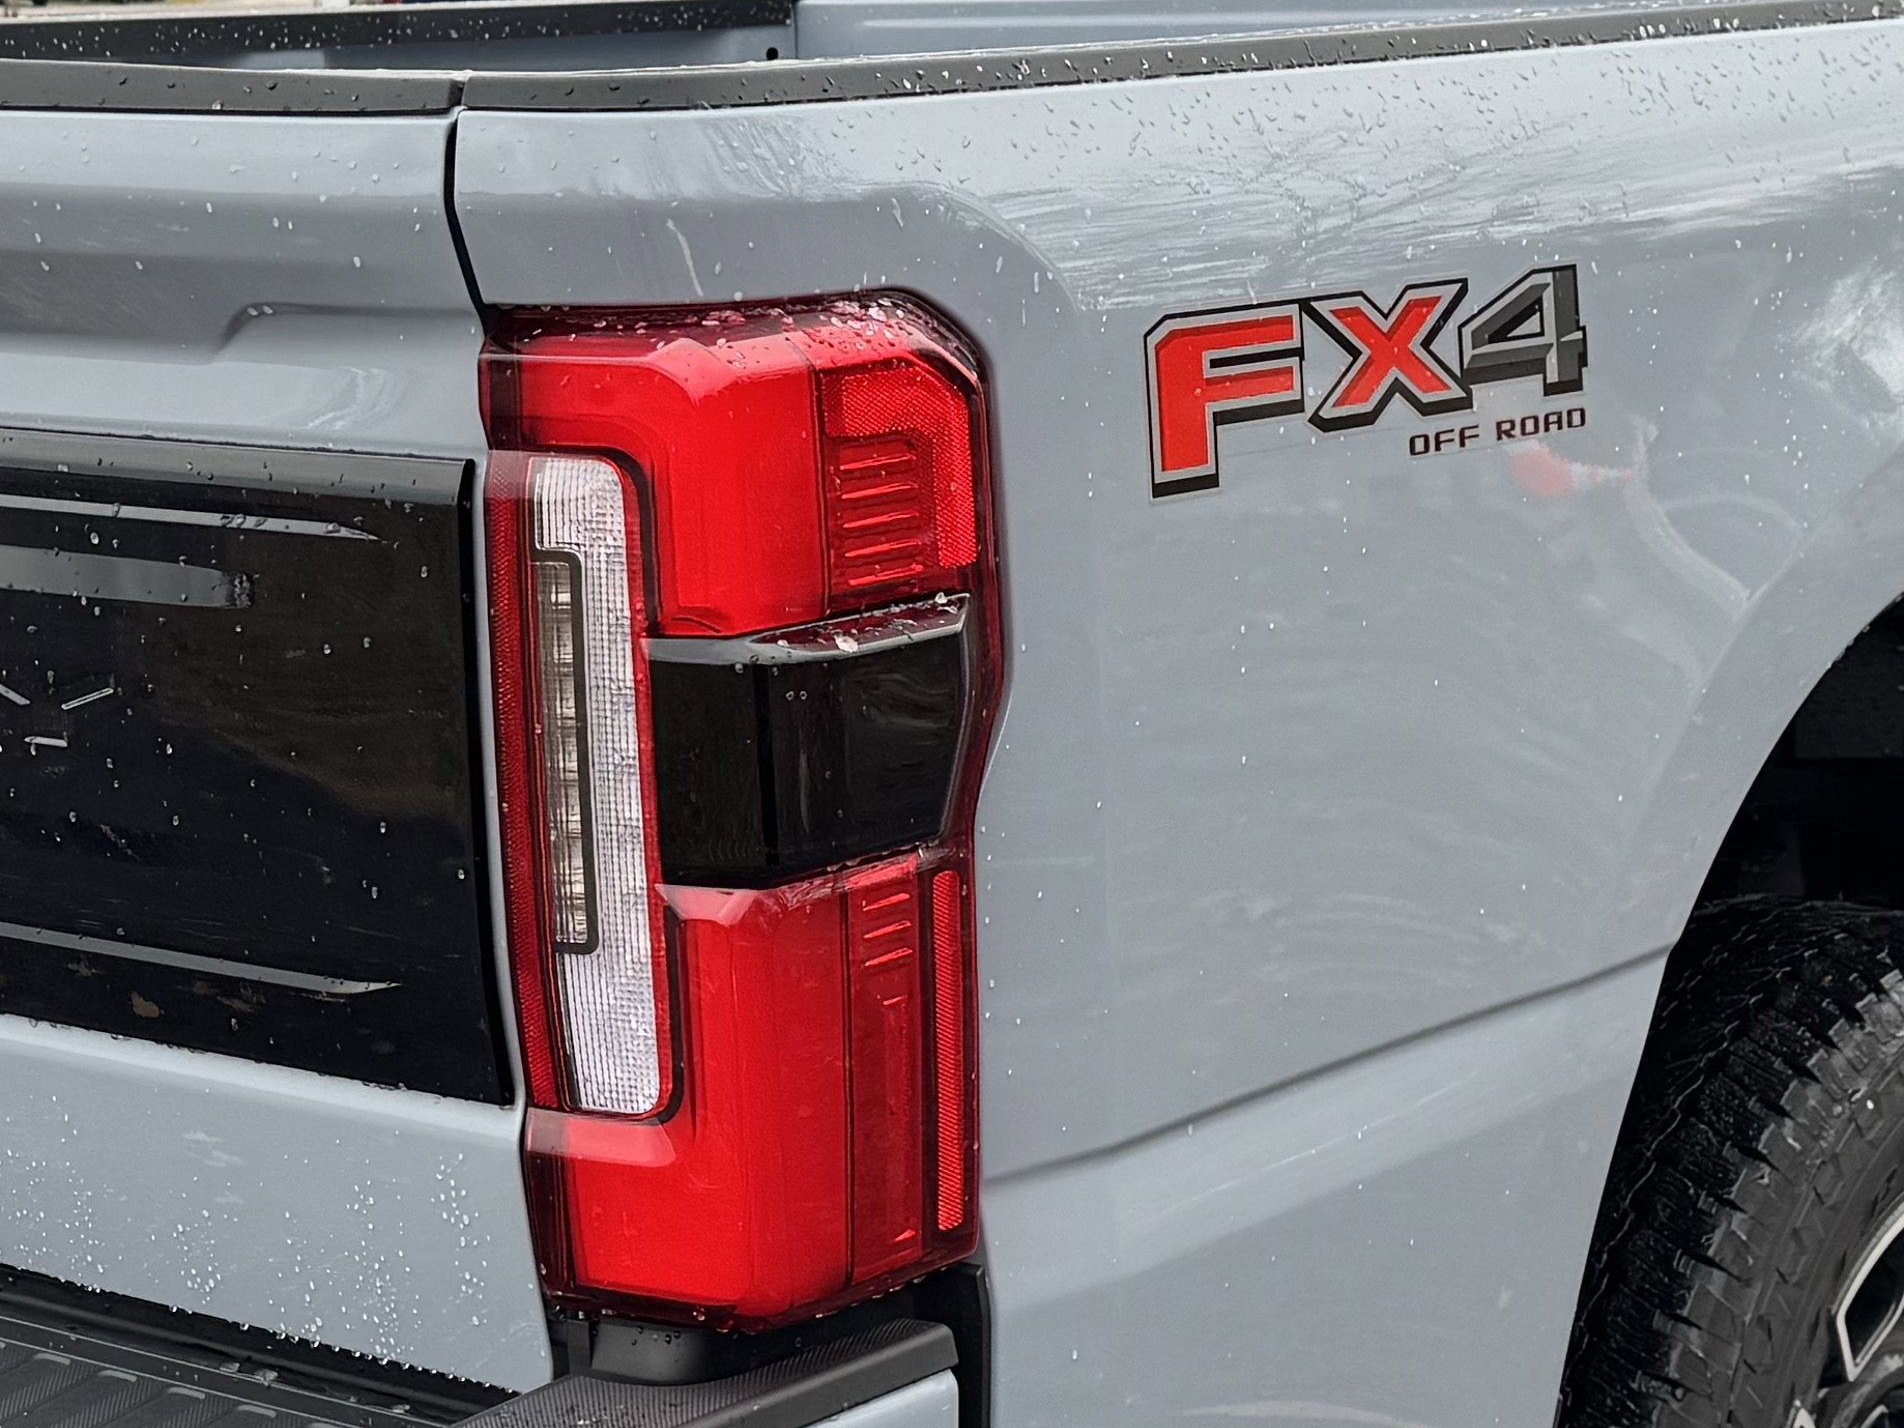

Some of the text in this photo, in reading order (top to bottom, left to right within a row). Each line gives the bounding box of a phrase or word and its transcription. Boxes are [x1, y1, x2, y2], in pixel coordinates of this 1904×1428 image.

[1143, 264, 1588, 500] FX4
[1408, 406, 1587, 458] OFF ROAD
